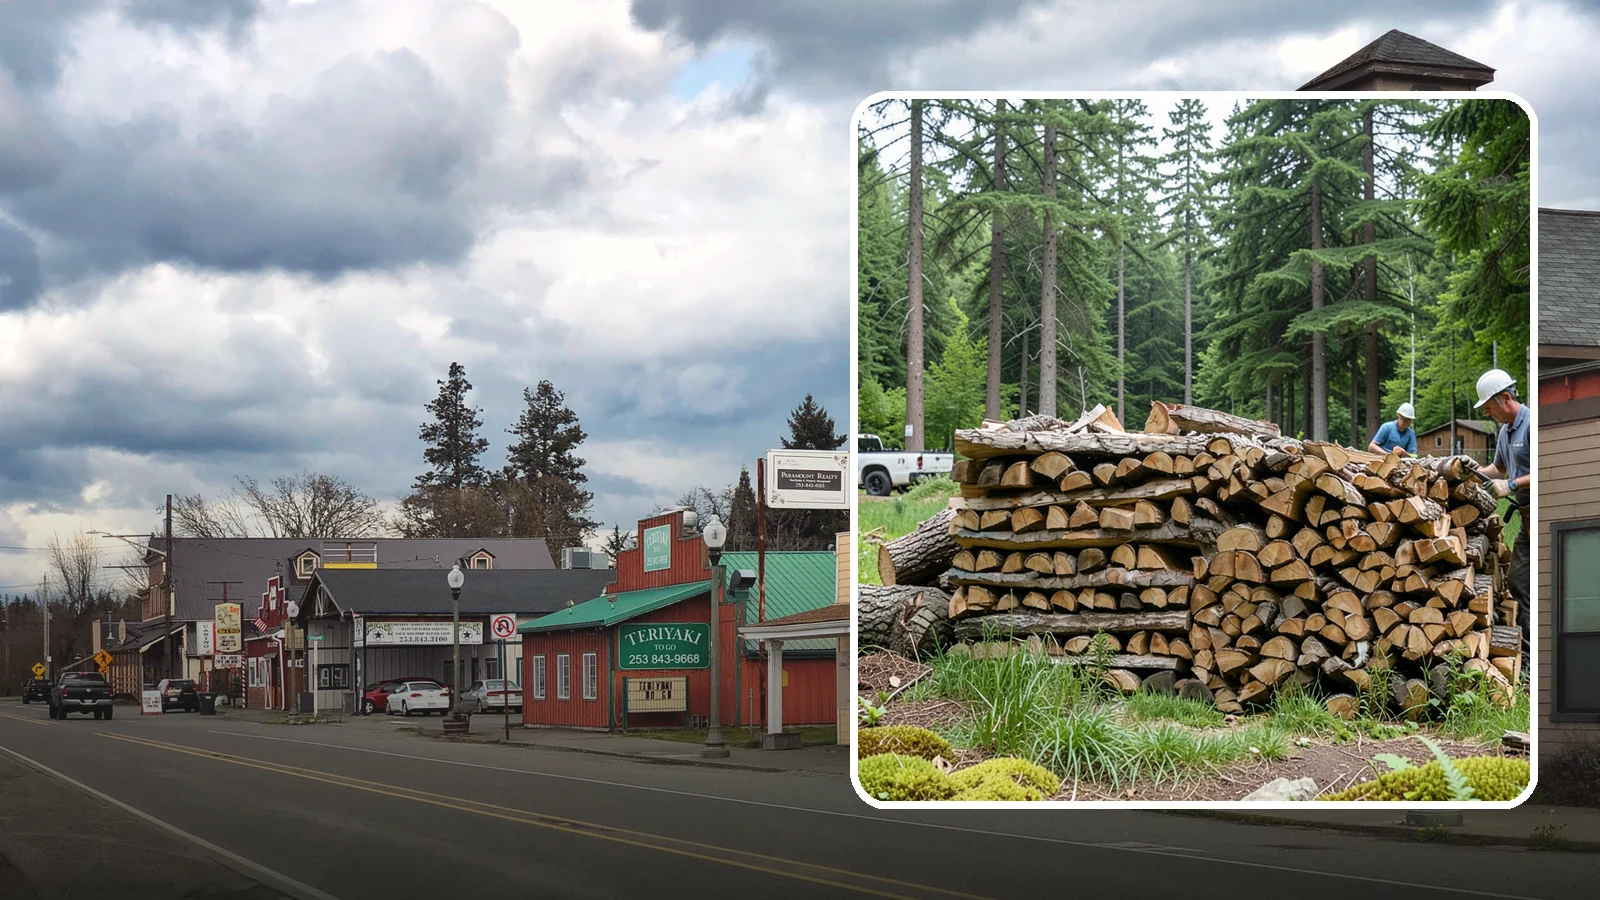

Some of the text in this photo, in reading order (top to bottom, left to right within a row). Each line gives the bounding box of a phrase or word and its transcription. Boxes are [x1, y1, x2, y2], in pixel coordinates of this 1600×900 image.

[625, 628, 702, 645] TERIYAKI
[629, 654, 700, 664] 253 843-9668
[639, 681, 672, 691] TERIYAKI
